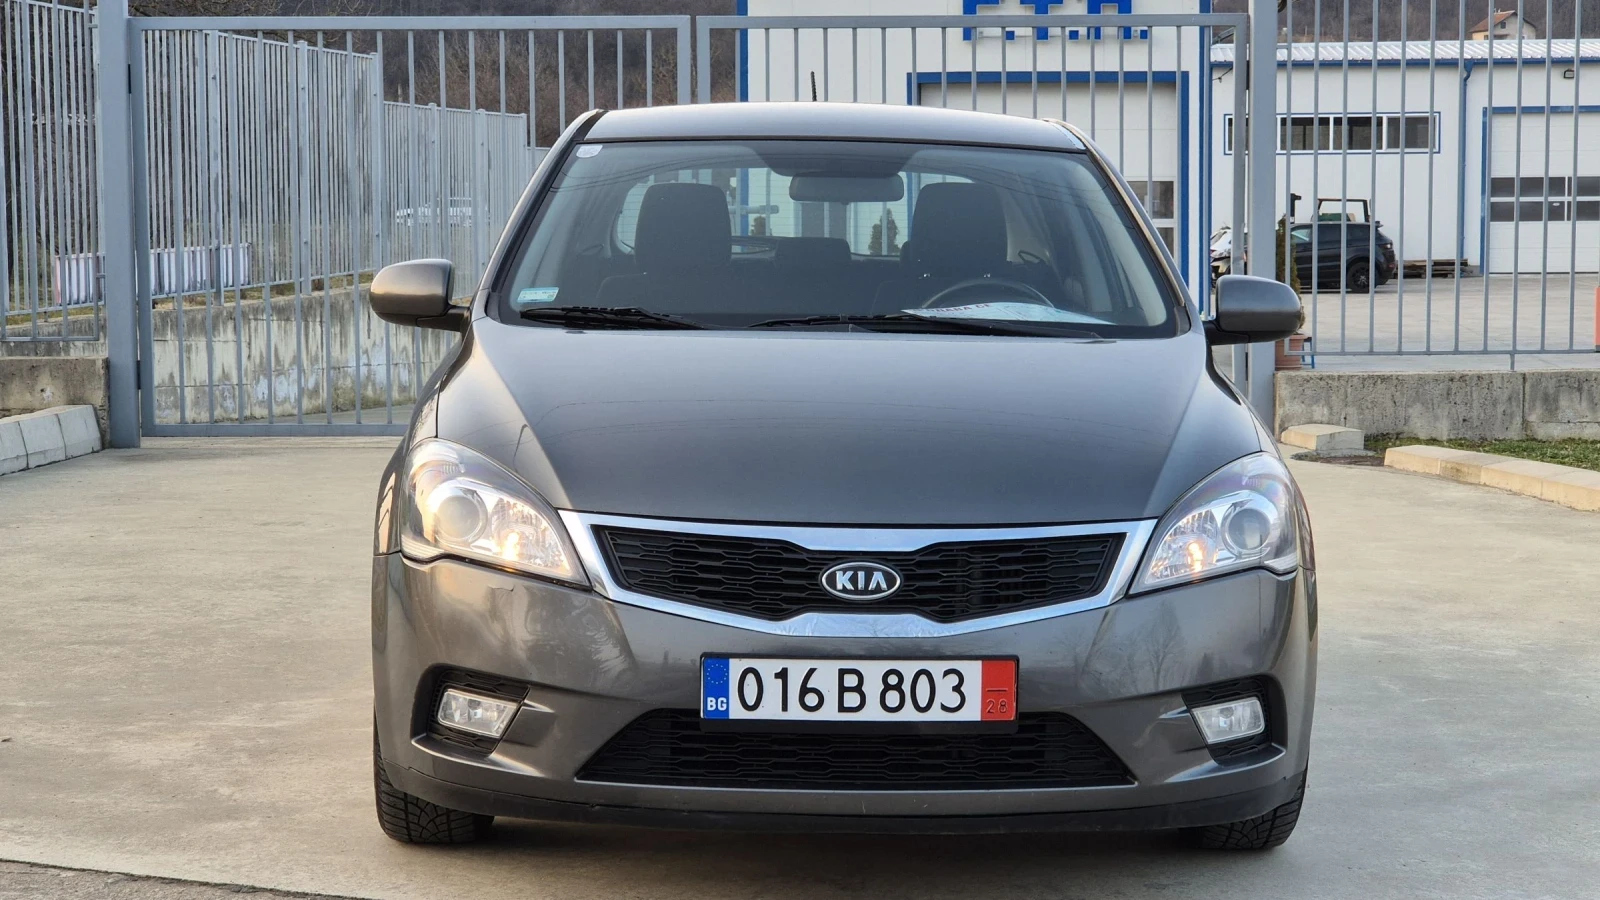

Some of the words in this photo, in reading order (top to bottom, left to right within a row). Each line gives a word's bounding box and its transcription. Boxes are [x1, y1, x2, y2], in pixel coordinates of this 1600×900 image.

[835, 570, 888, 590] KIA
[707, 696, 727, 711] BG
[986, 698, 1008, 714] 28
